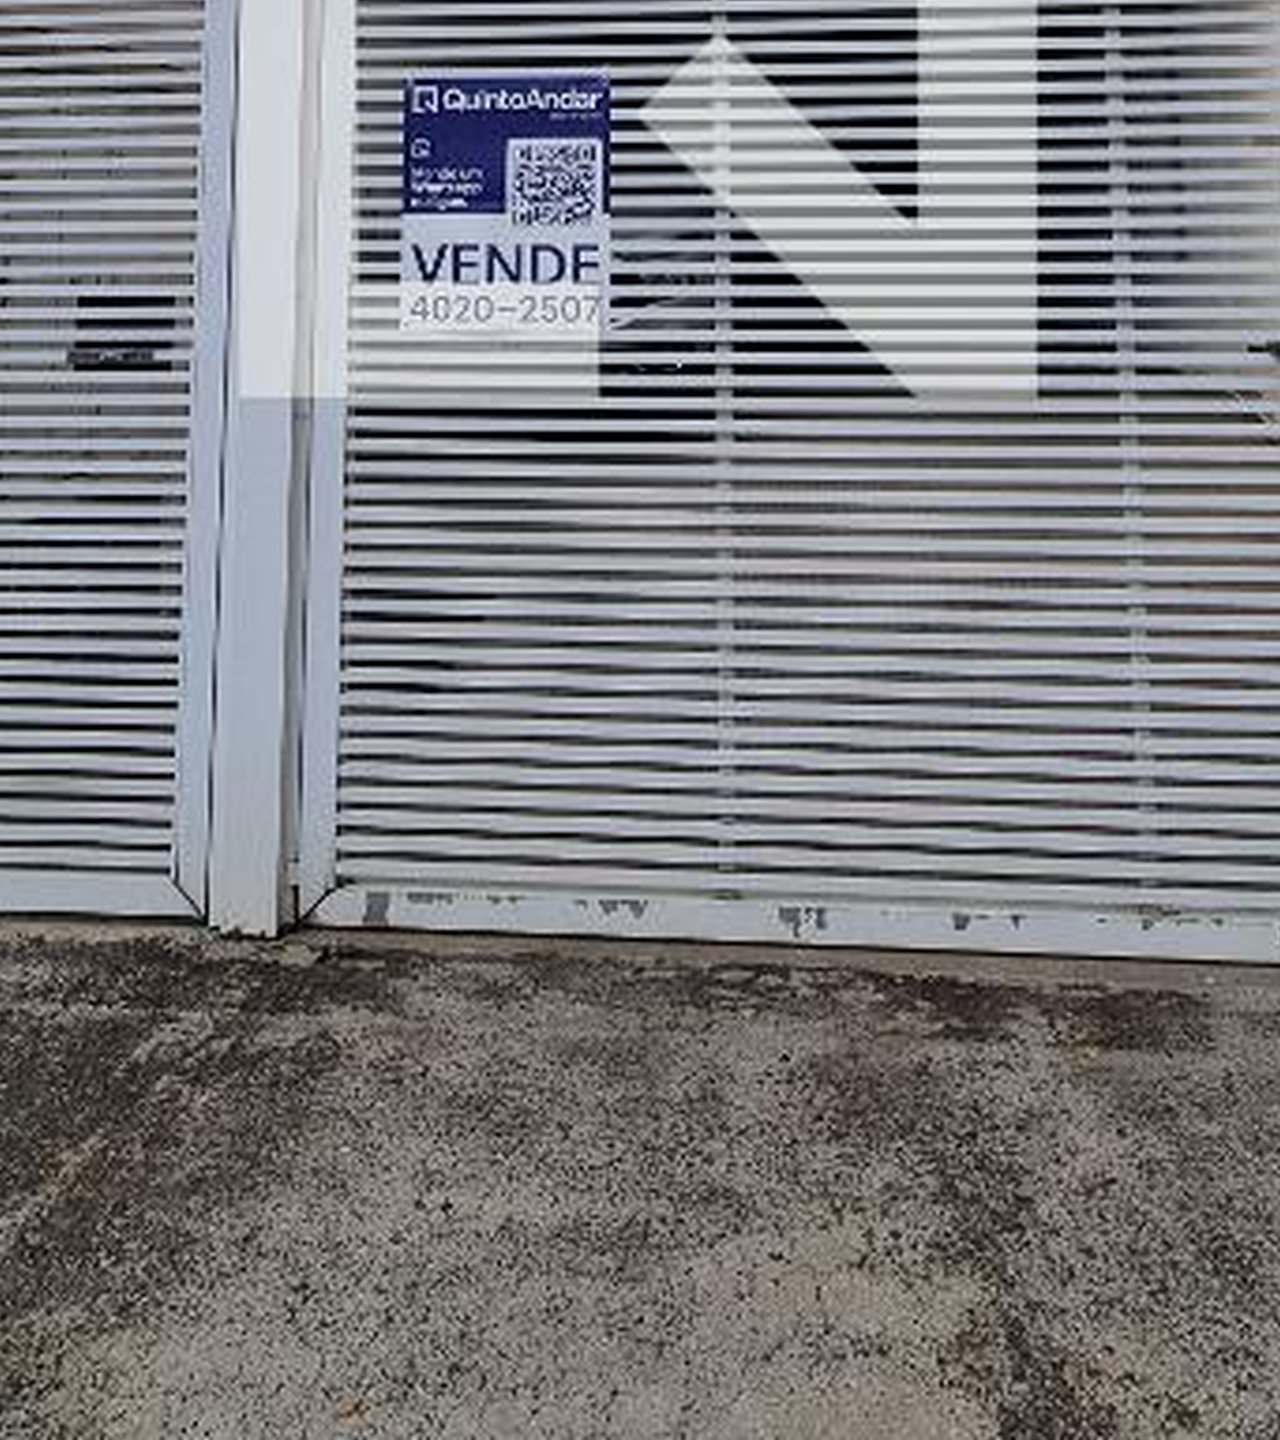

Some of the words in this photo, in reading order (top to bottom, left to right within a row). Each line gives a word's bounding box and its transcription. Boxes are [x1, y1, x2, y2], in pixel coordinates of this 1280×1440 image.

[442, 88, 604, 111] QuintoAndar
[410, 244, 600, 285] VENDE
[409, 295, 600, 323] 4020-2507
